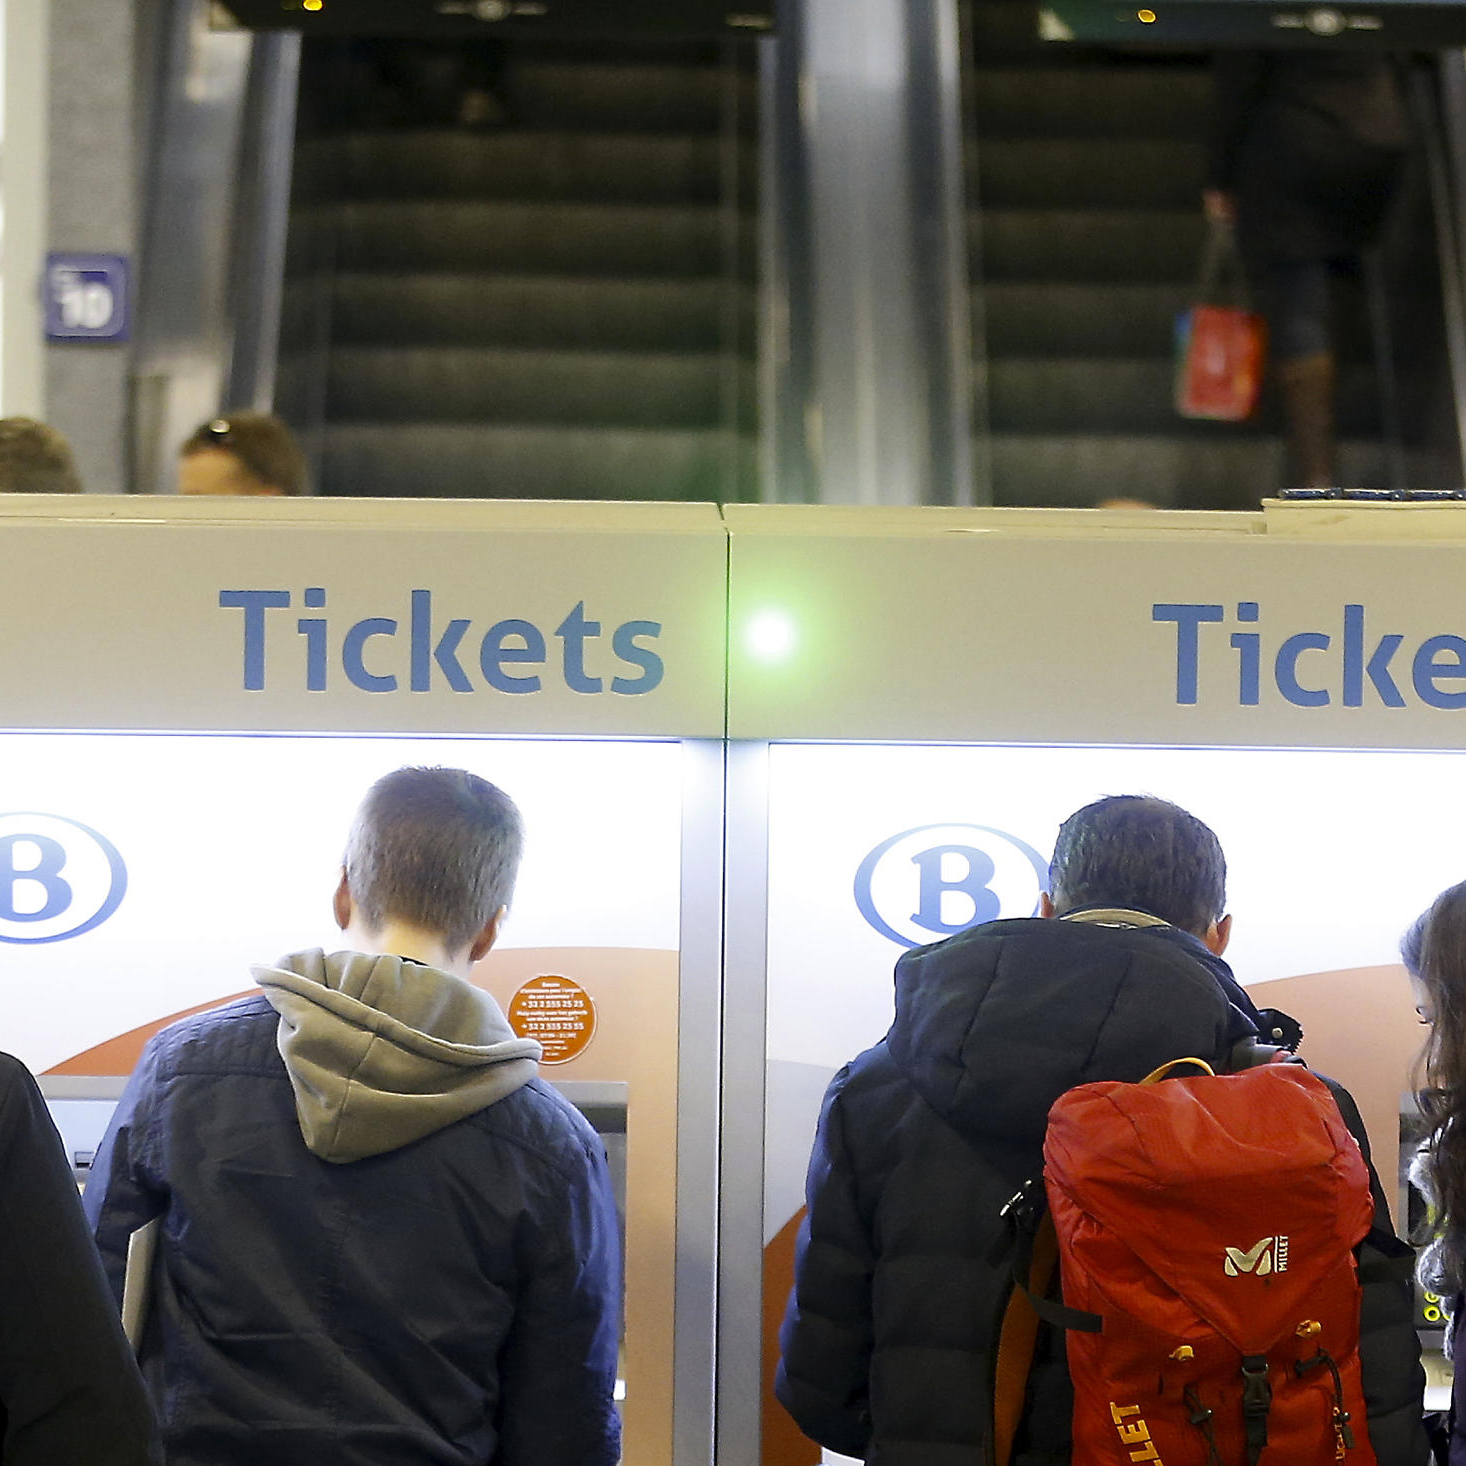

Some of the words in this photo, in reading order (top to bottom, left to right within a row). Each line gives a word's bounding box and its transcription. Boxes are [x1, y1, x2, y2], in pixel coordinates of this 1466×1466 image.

[218, 587, 665, 696] Tickets
[910, 844, 1002, 935] B
[1278, 1235, 1289, 1272] MILLET
